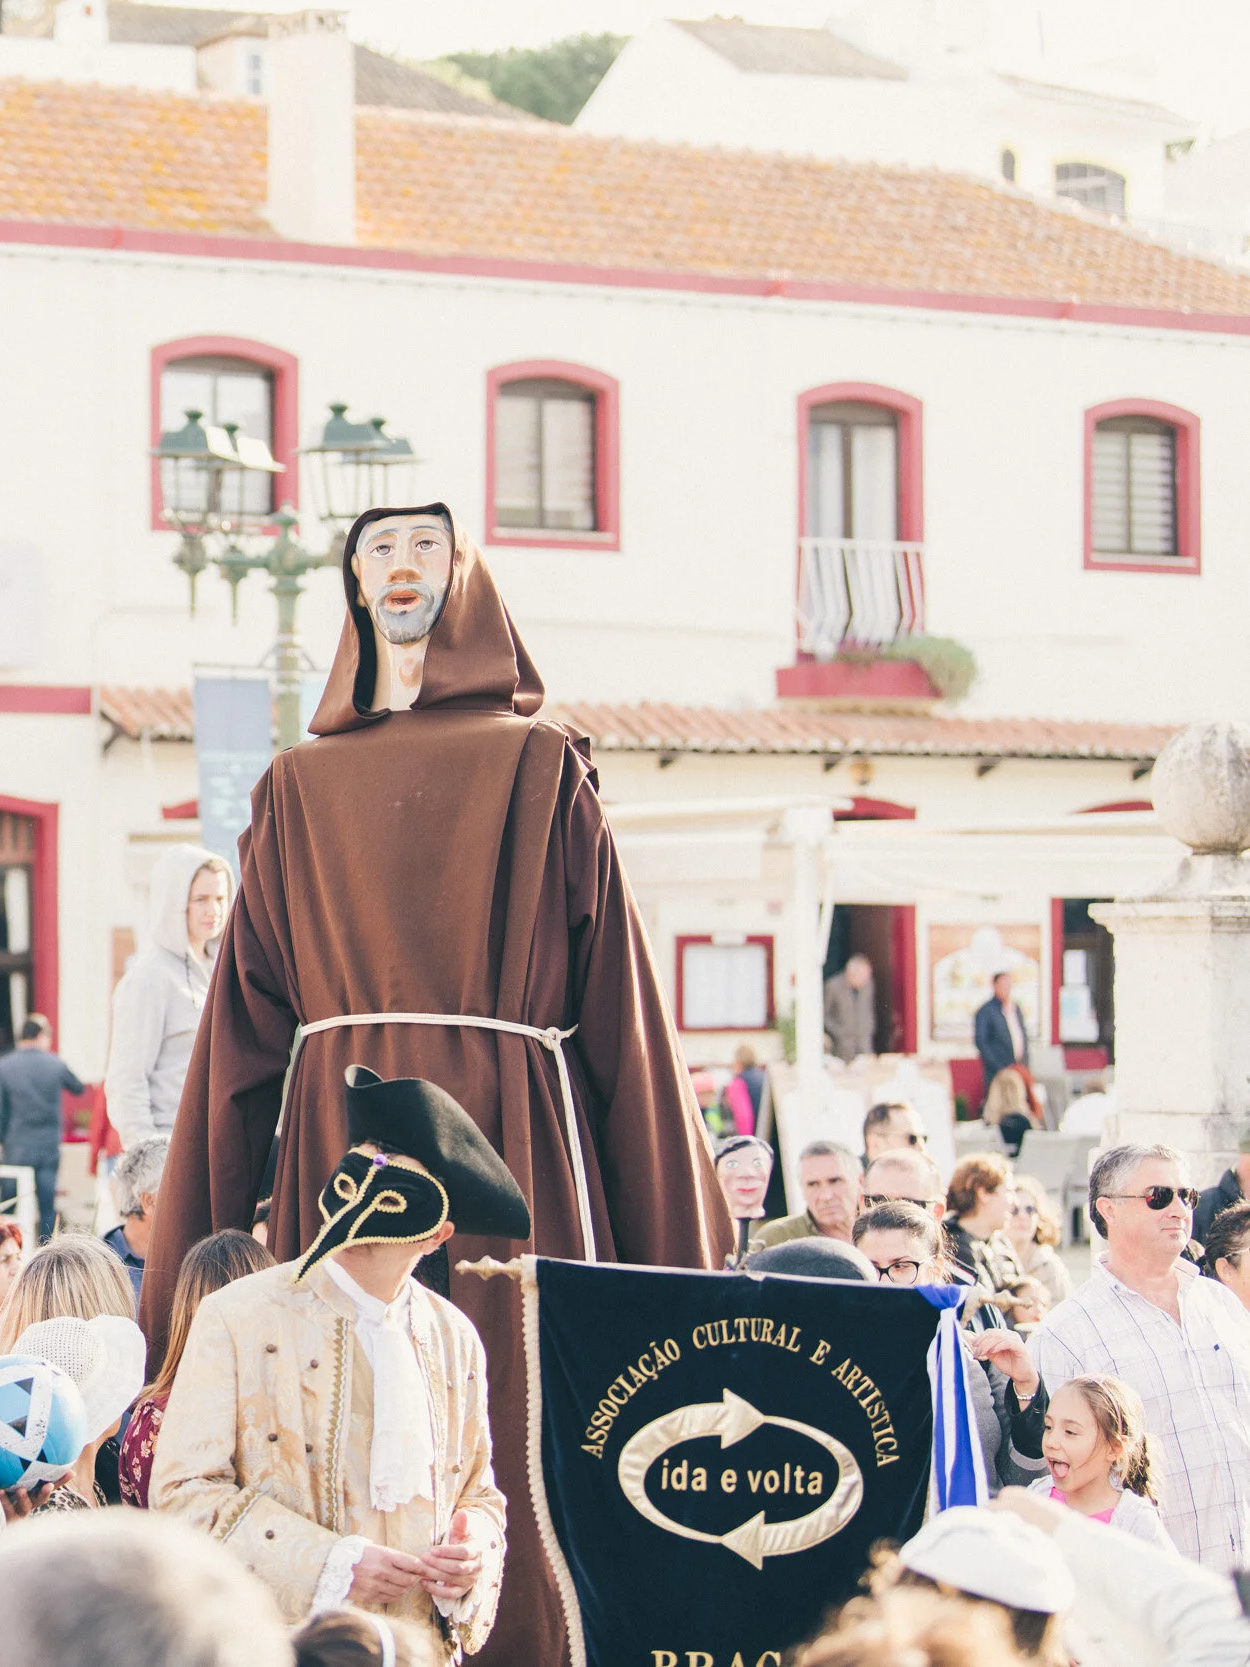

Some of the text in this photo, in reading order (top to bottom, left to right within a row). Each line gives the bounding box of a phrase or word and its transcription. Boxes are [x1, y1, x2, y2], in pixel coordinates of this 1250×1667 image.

[580, 1317, 900, 1468] ASSOCIAÇÃO CULTURAL E ARTISTICA
[660, 1459, 824, 1496] ida e volta
